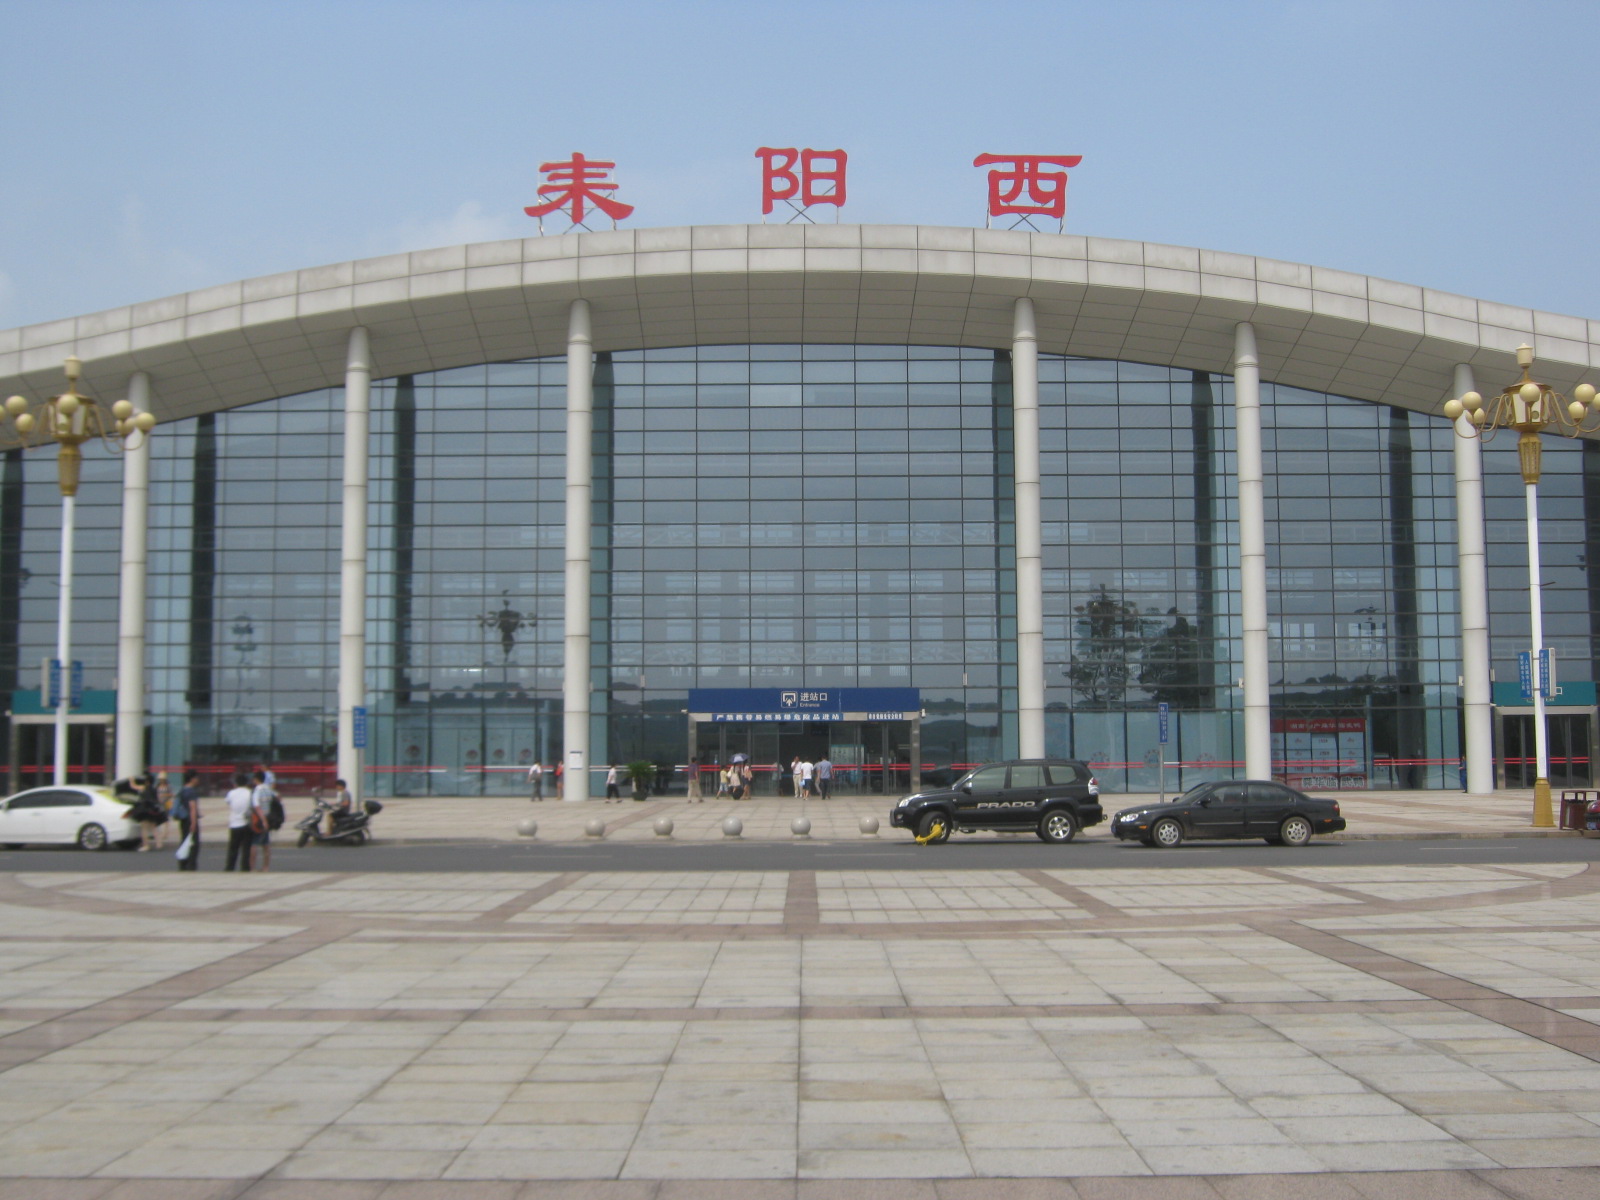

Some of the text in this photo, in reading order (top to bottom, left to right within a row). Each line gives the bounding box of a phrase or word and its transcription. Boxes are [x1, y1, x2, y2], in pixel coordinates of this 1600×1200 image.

[524, 146, 1083, 224] 耒阳西
[800, 692, 828, 702] 进站口
[976, 801, 1036, 809] PRADO
